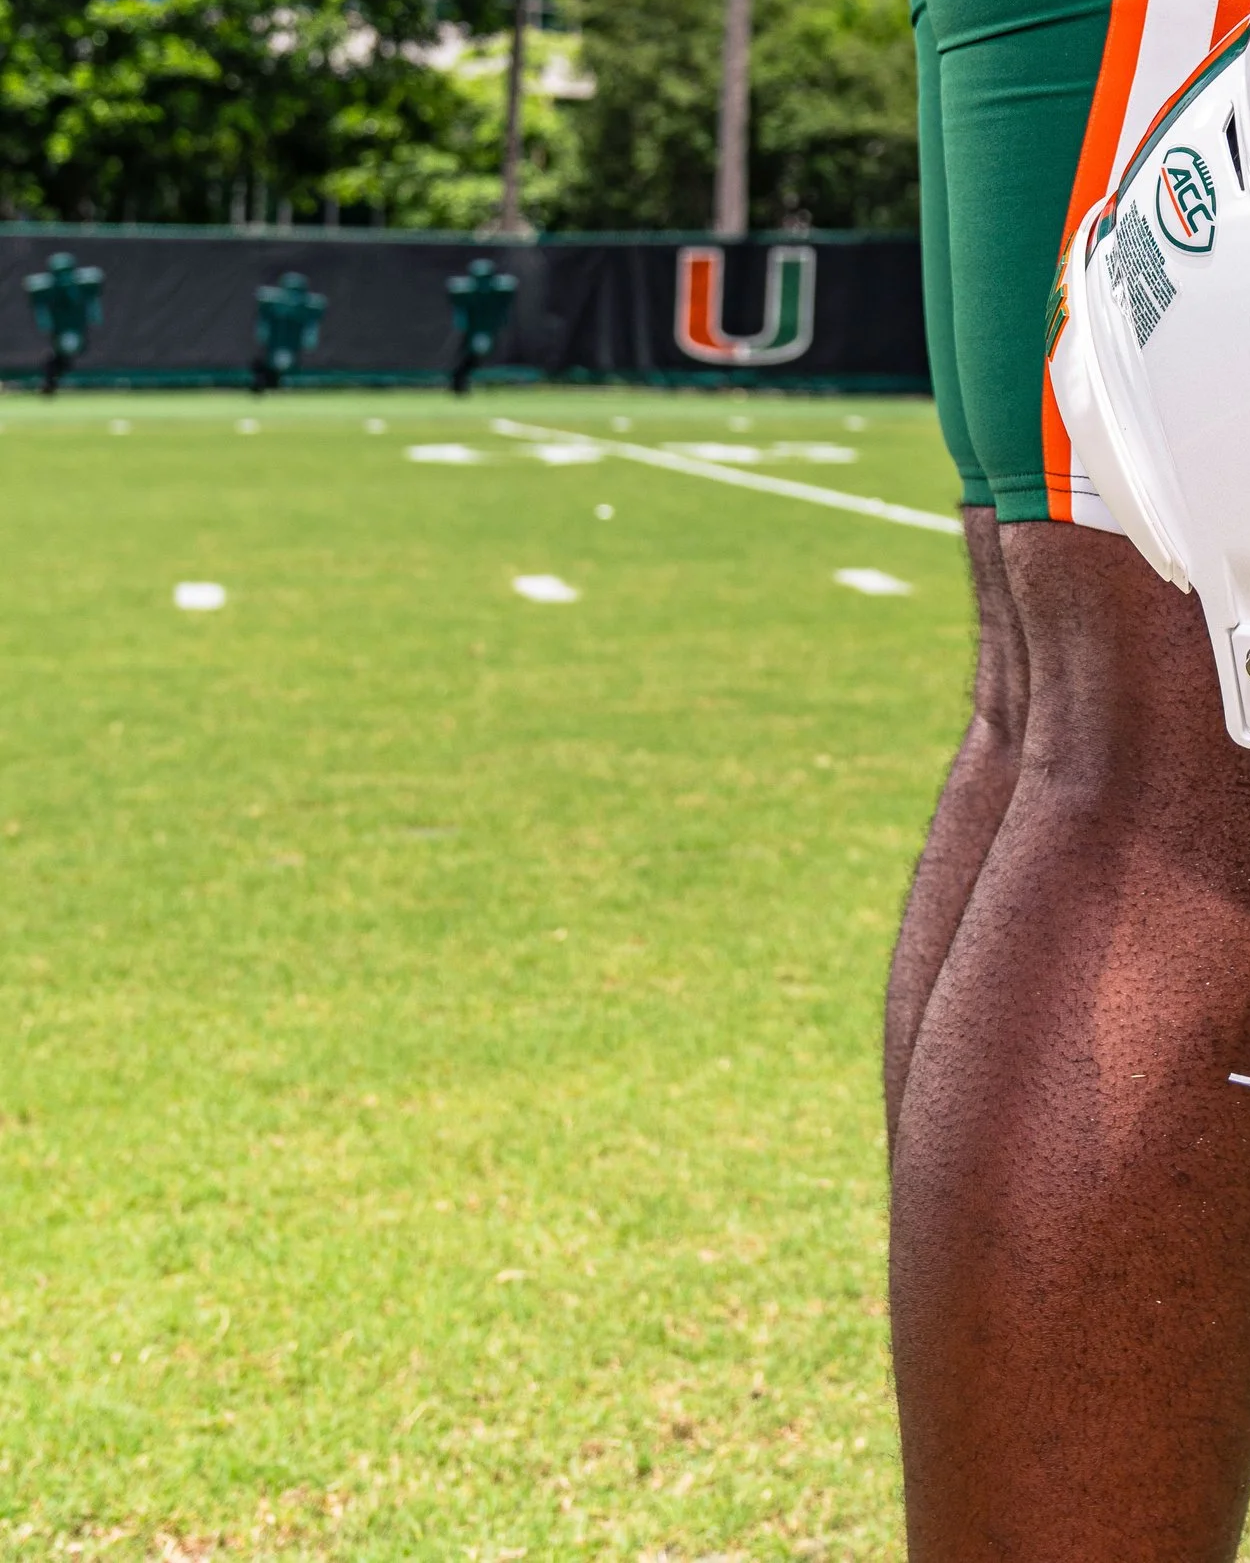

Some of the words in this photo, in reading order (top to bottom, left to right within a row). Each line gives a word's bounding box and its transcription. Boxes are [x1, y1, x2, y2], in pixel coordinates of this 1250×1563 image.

[1167, 168, 1214, 233] ACC
[1141, 214, 1166, 266] WARNING
[673, 245, 817, 366] U
